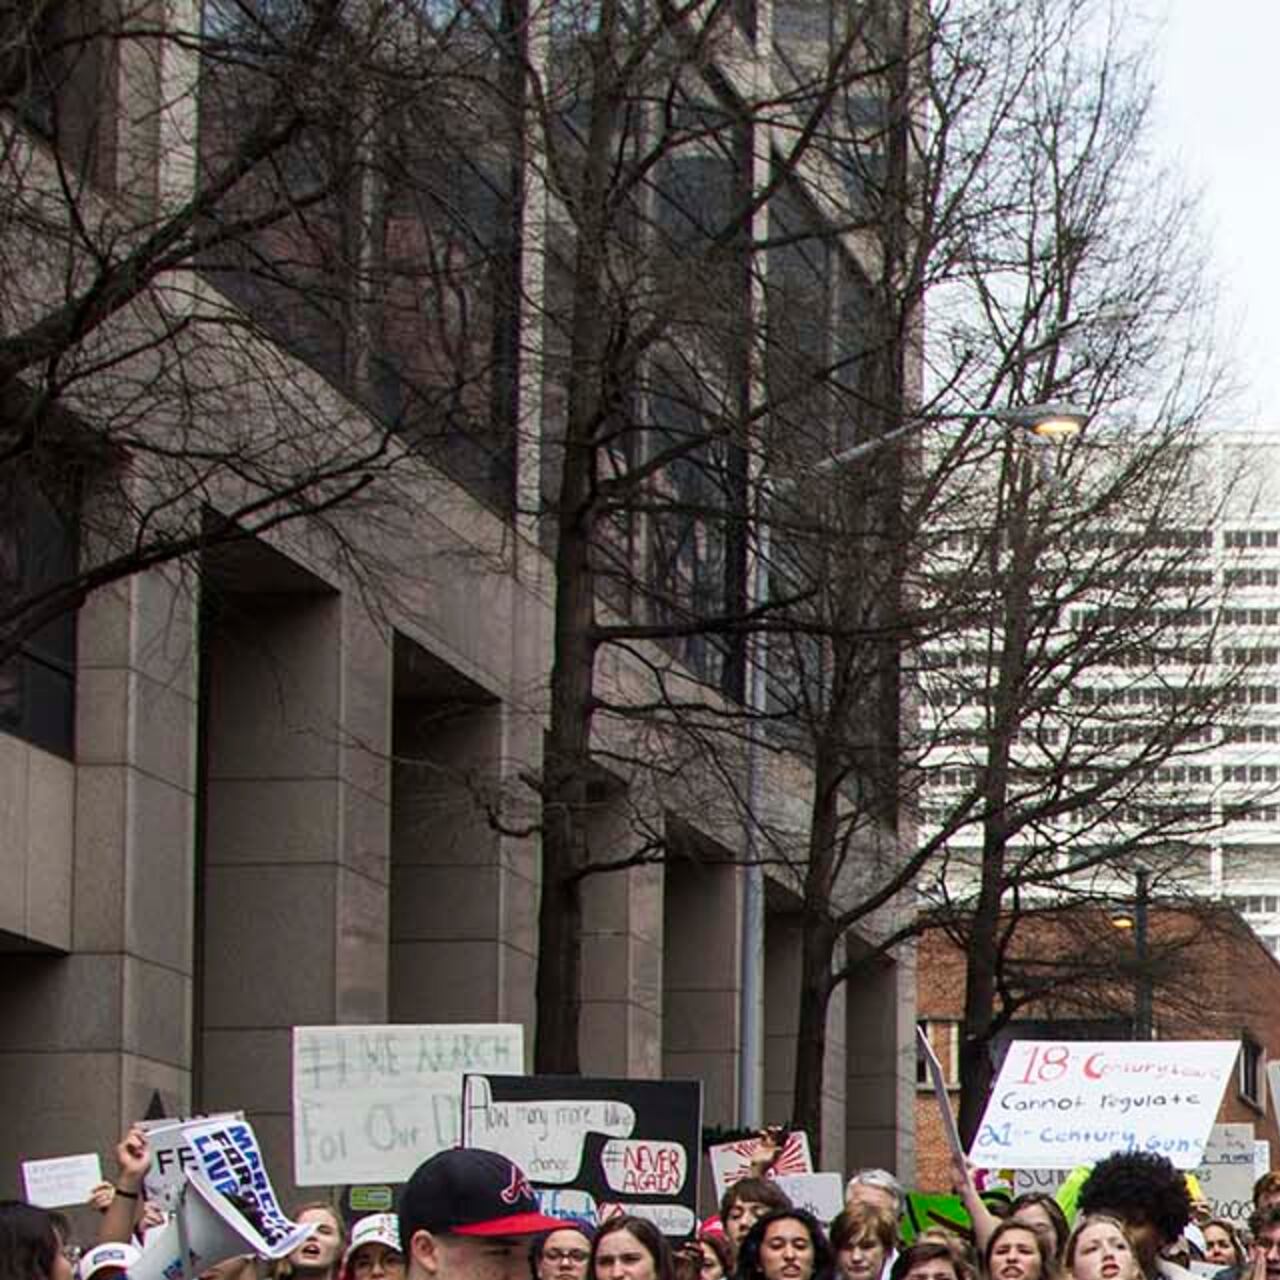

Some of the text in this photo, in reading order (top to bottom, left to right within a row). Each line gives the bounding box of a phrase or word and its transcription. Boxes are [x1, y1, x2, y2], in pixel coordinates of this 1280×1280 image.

[1001, 1092, 1200, 1113] Cannot regulate
[195, 1135, 241, 1196] LIVE
[623, 1169, 681, 1192] AGAIN
